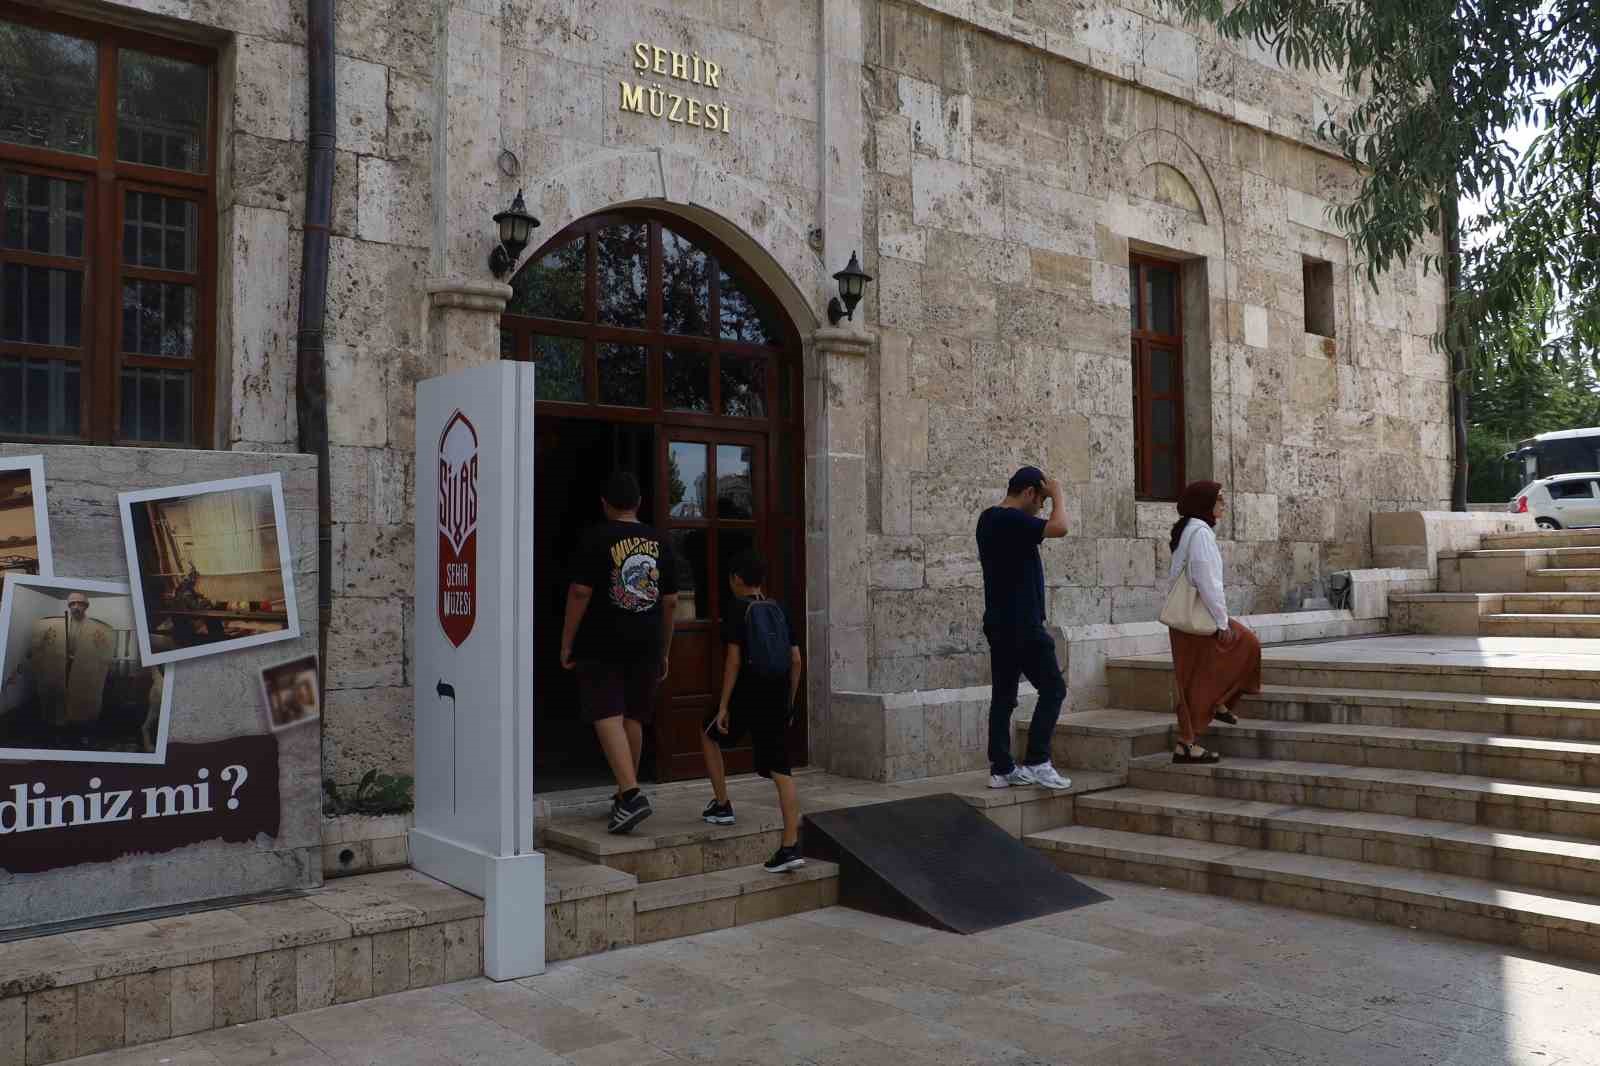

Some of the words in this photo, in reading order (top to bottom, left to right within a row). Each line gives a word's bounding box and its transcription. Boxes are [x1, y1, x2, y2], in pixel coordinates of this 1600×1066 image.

[619, 81, 731, 133] MÜZESİ
[443, 591, 472, 616] MÜZESİ
[0, 777, 133, 834] diniz
[141, 768, 213, 818] mi
